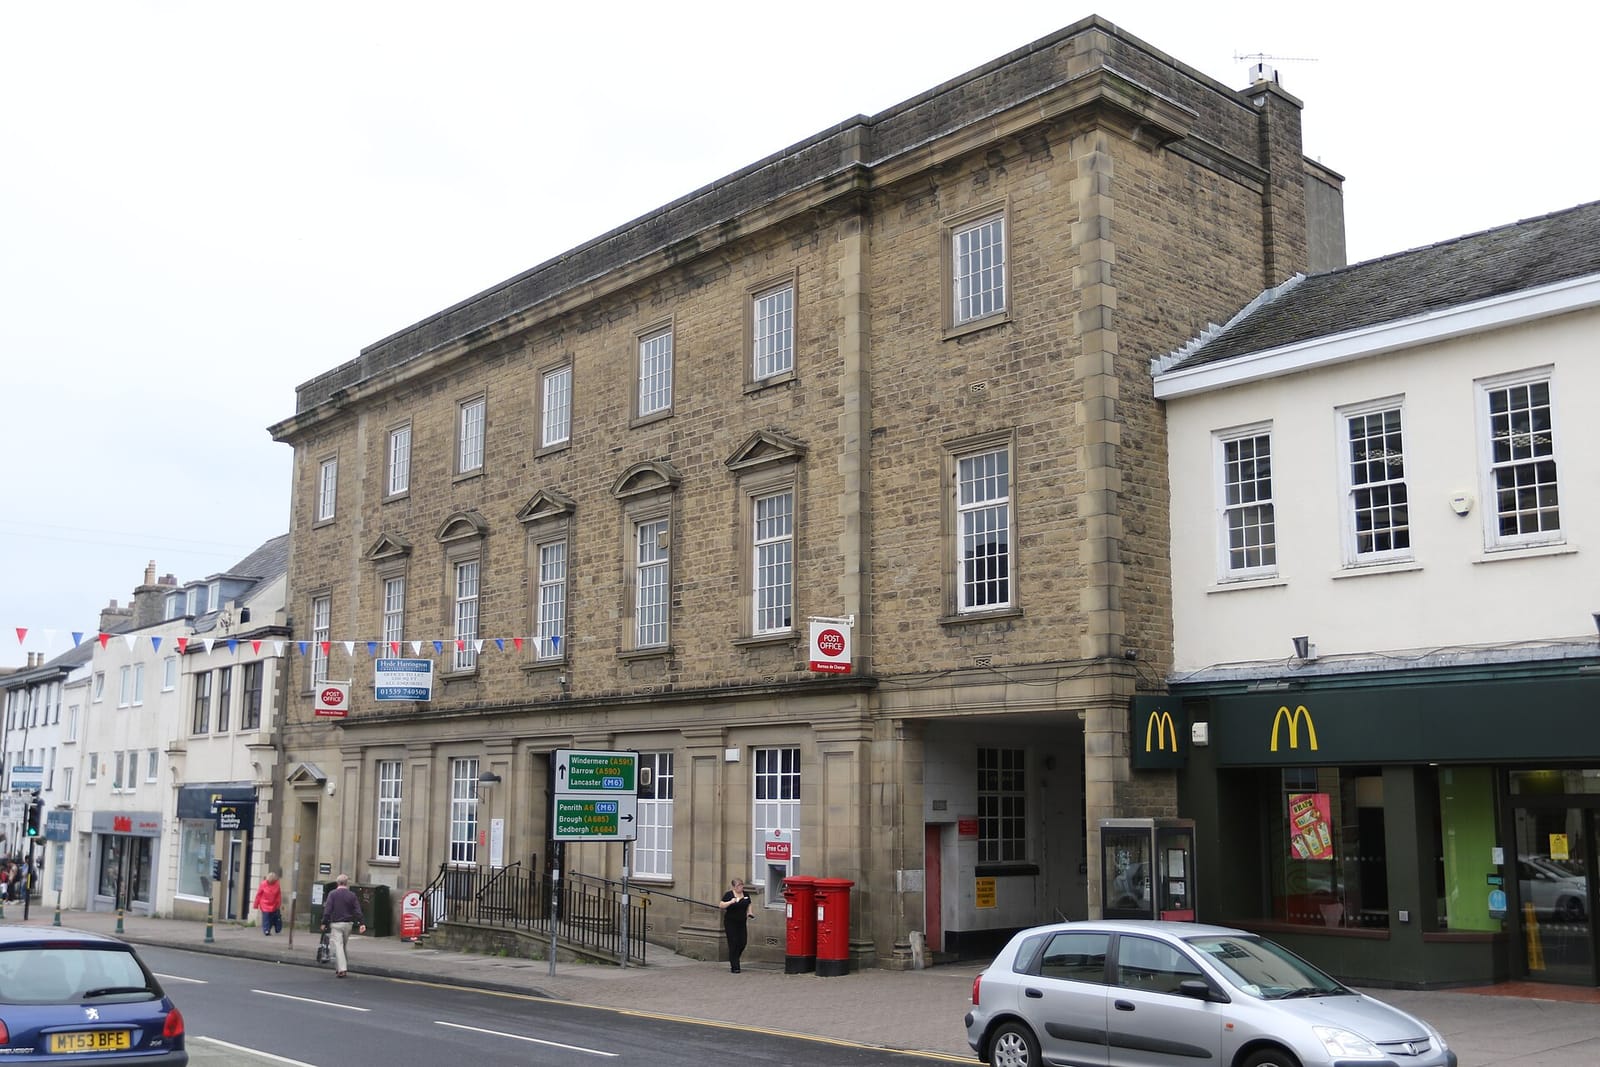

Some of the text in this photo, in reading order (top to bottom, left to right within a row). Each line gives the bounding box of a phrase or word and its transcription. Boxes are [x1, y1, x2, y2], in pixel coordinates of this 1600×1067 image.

[824, 634, 840, 642] POST
[820, 642, 843, 650] OFFICE
[571, 757, 608, 765] Windermere
[558, 826, 590, 834] Sedbergh
[767, 844, 789, 852] Free Cash
[57, 1032, 124, 1048] MT53 BFE
